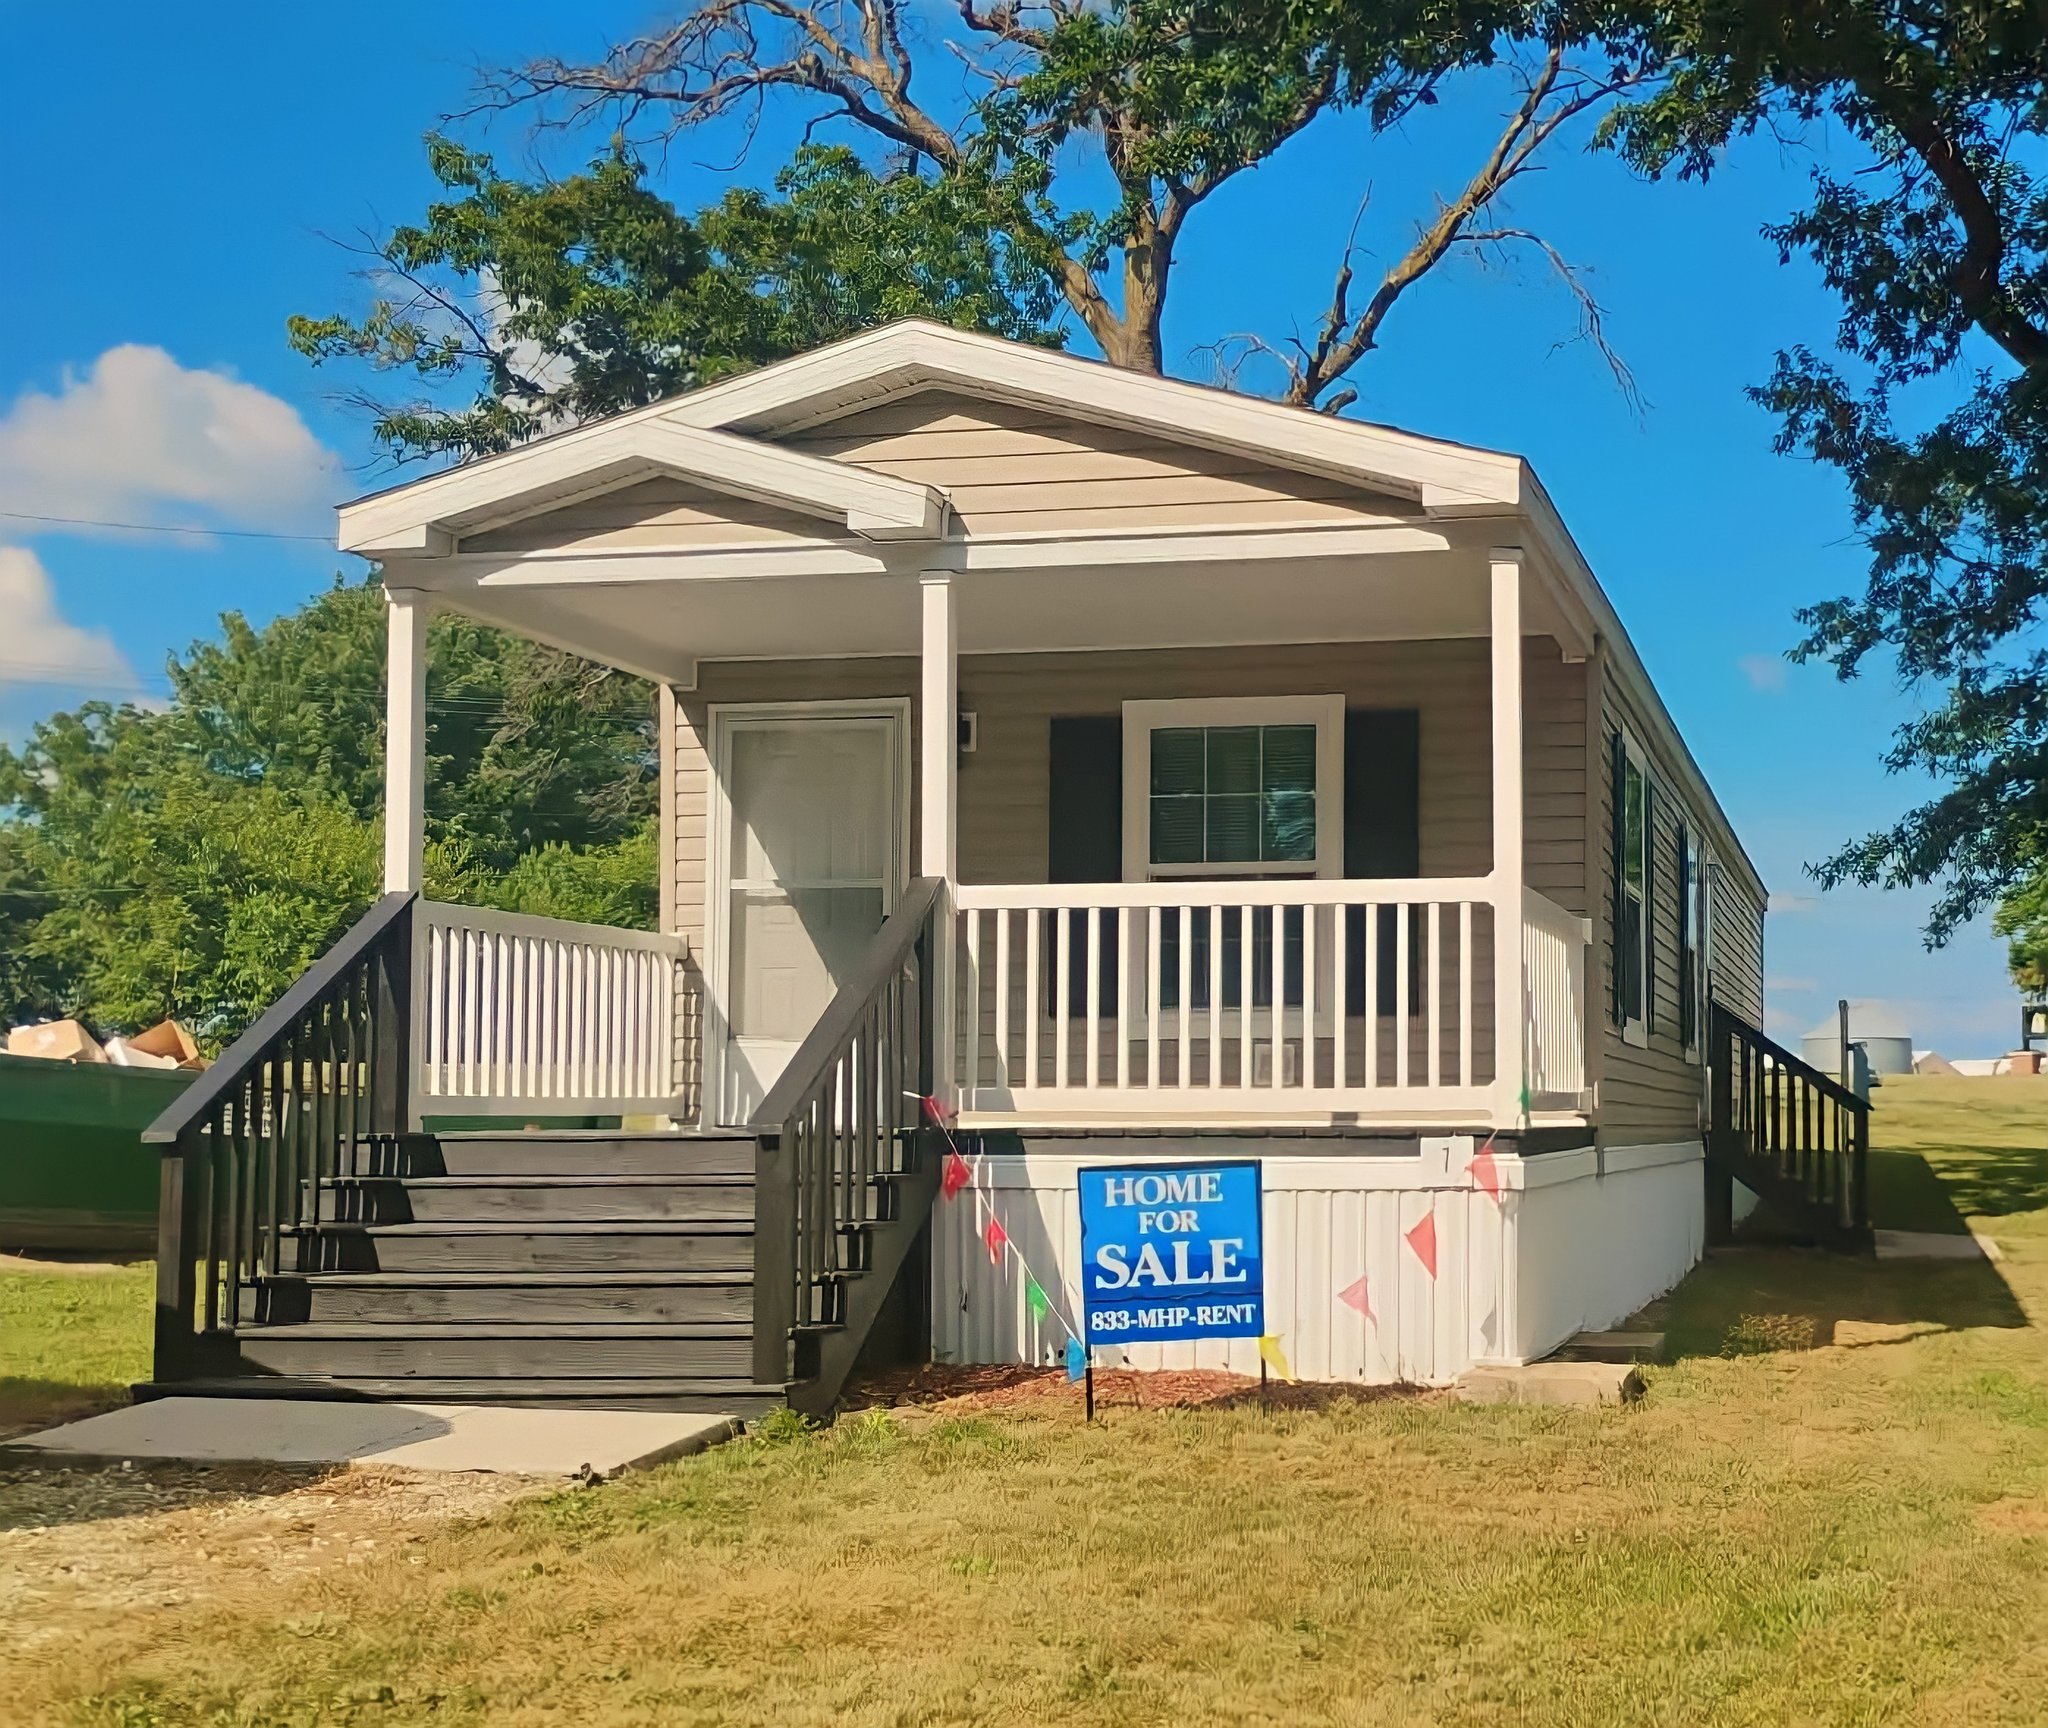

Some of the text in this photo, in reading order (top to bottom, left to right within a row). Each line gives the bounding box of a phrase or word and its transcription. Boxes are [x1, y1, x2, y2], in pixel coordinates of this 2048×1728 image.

[1104, 1172, 1223, 1207] HOME
[1139, 1210, 1200, 1234] FOR
[1095, 1238, 1247, 1289] SALE
[1091, 1303, 1257, 1331] 833-MHP-RENT
